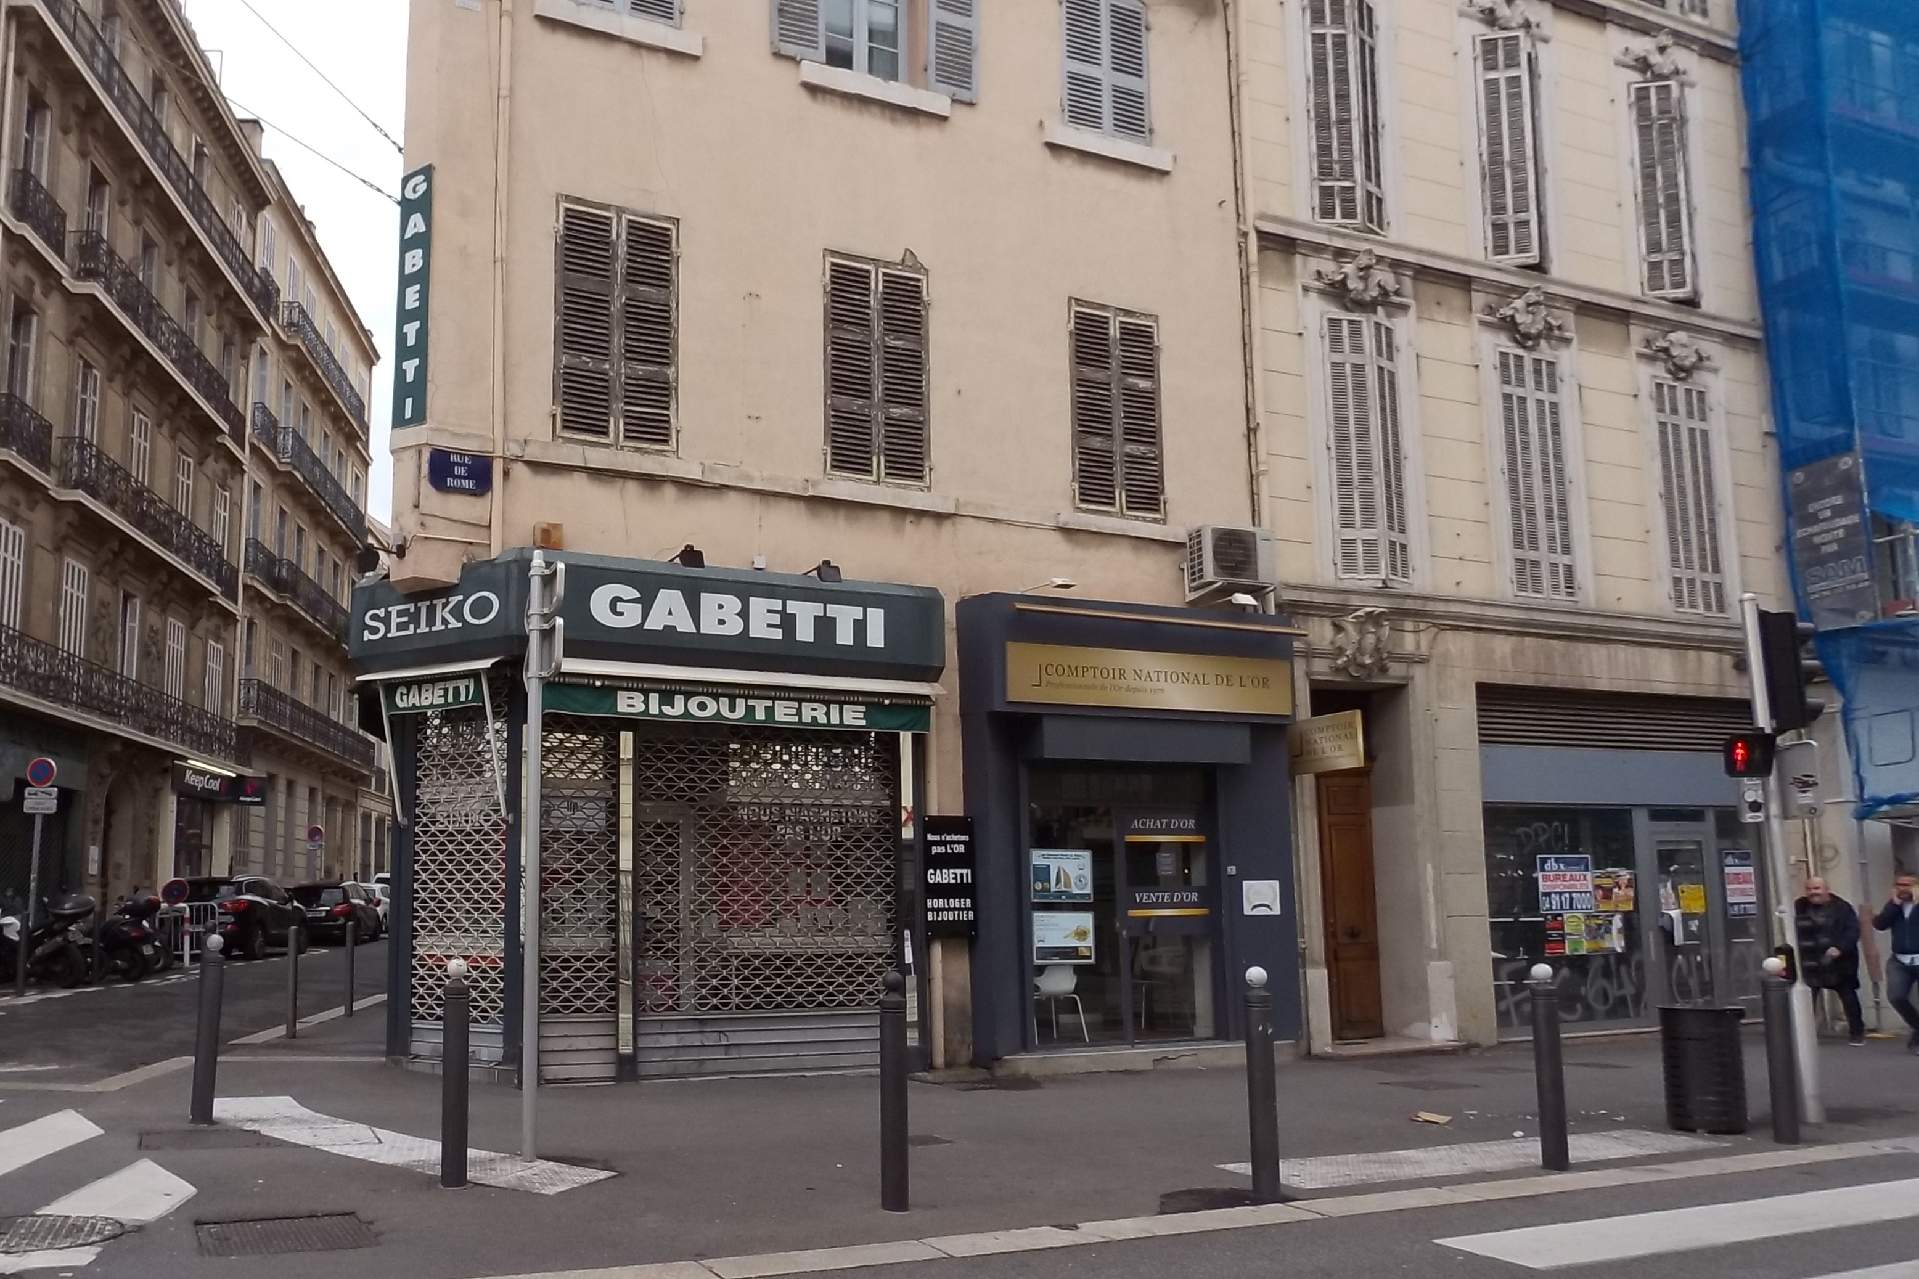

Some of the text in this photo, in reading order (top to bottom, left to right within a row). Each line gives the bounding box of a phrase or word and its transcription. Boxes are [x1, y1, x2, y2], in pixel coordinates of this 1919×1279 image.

[402, 174, 427, 420] GABETTI
[450, 453, 472, 465] RUE
[454, 466, 468, 476] DE
[447, 478, 477, 489] ROME
[363, 591, 500, 641] SEIKO
[590, 583, 885, 648] GABETTI
[1044, 663, 1271, 689] COMPTOIR NATIONAL DE L'OR
[395, 678, 475, 708] GABETTI
[616, 691, 867, 726] BIJOUTERIE
[184, 769, 221, 792] Keep Cool
[1131, 819, 1196, 829] ACHAT D'OR
[931, 843, 965, 855] pas L'OR
[927, 868, 972, 884] GABETTI
[1541, 873, 1588, 883] BUREAUX
[927, 898, 972, 909] HORLOGER
[1135, 892, 1198, 903] VENTE D'OR
[927, 911, 974, 921] BIJOUTIER
